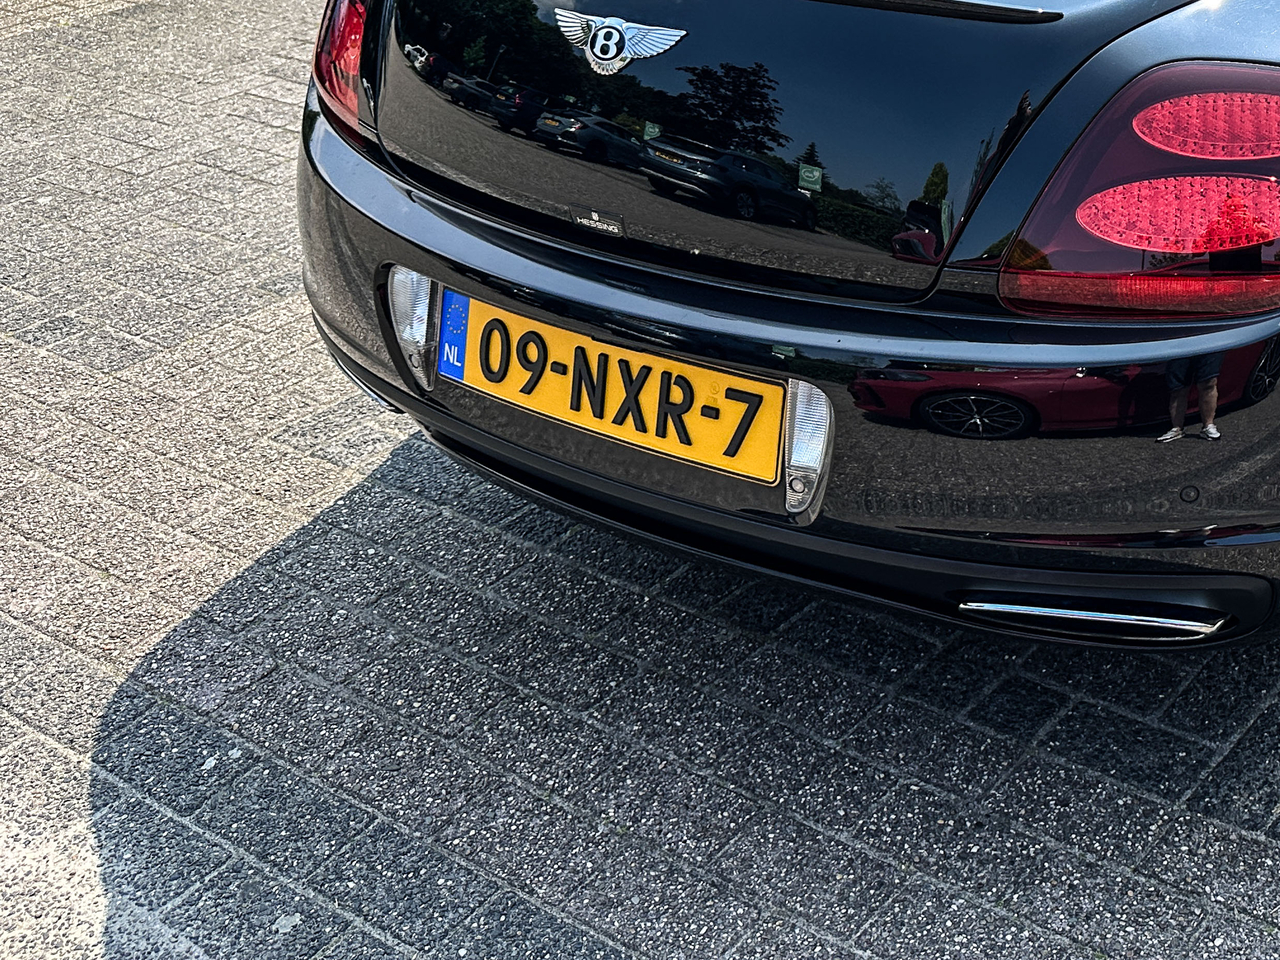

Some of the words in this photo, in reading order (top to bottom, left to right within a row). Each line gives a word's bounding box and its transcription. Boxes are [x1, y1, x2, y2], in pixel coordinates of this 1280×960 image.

[576, 216, 619, 233] HESSING
[443, 342, 462, 368] NL
[479, 318, 764, 458] 09-NXR-7
